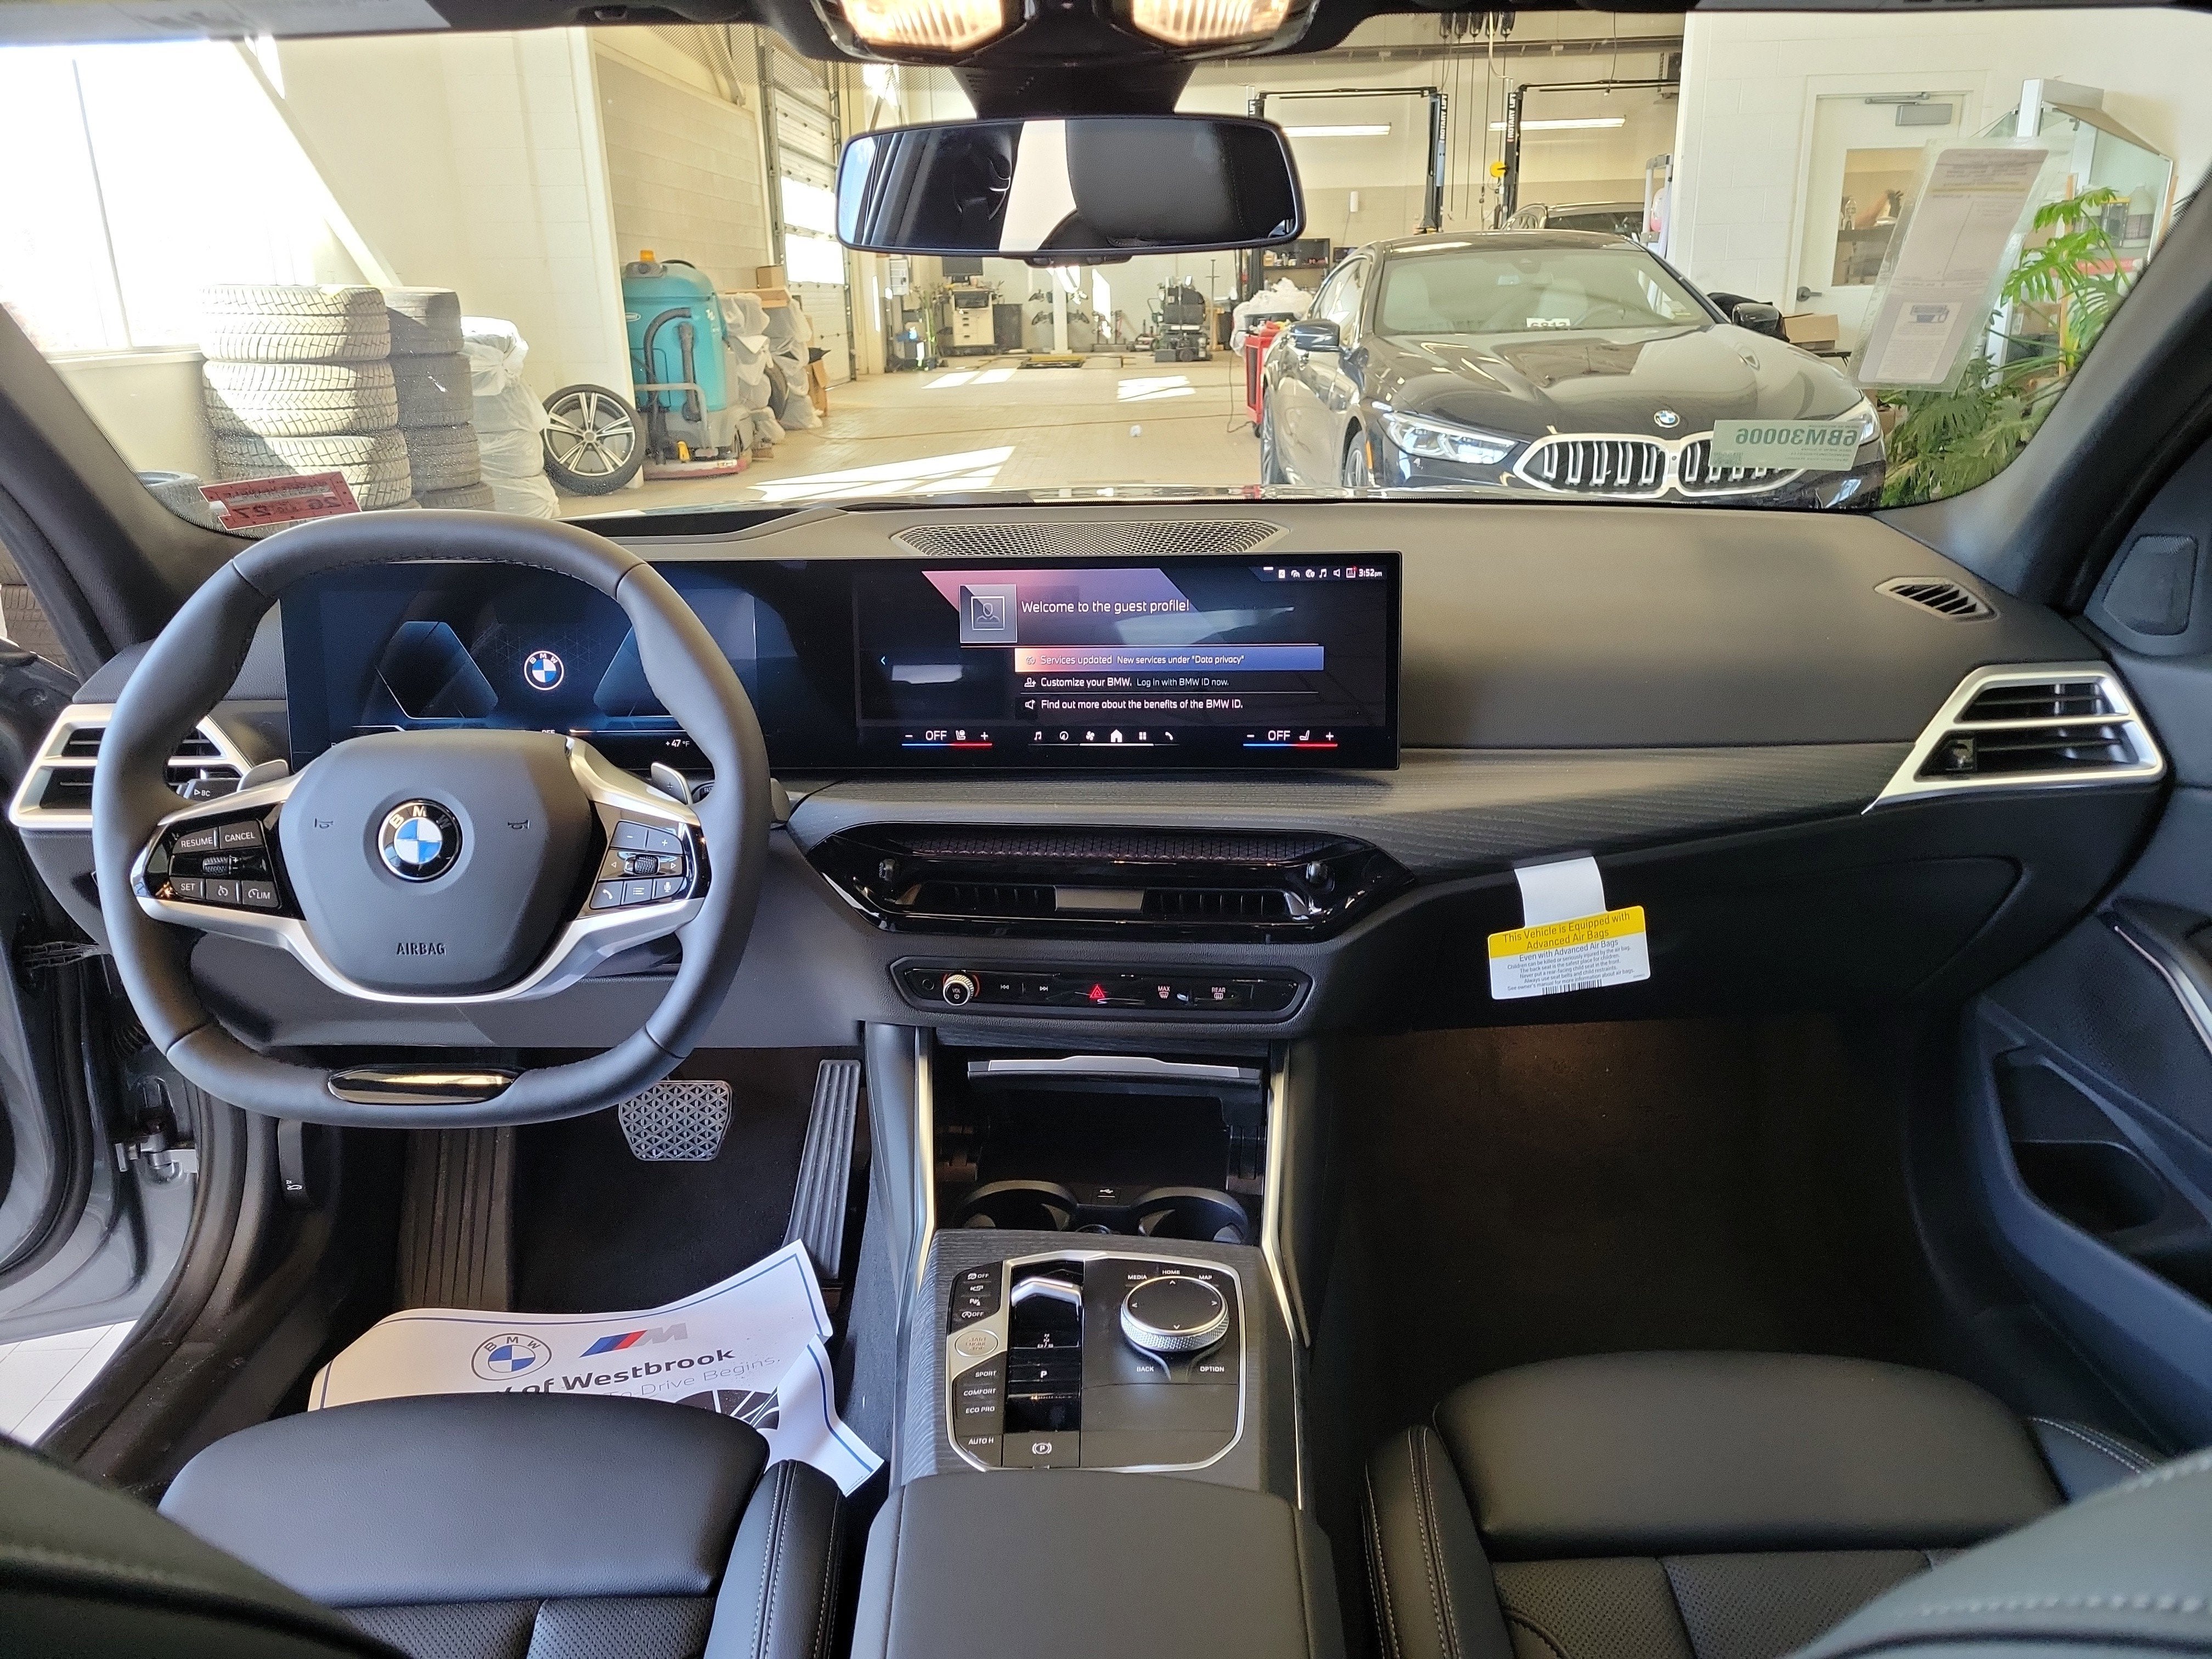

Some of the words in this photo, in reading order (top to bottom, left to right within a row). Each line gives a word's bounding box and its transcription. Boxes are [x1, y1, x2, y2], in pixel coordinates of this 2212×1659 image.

[1359, 569, 1382, 577] 3:52pm
[1022, 601, 1074, 613] Welcome
[1078, 601, 1089, 612] to
[1092, 600, 1111, 612] the
[1114, 600, 1147, 614] guest
[1150, 599, 1190, 614] profile!
[1040, 656, 1075, 665] Services
[1077, 655, 1112, 666] updated
[1117, 656, 1134, 664] New
[1136, 656, 1166, 664] services
[1168, 655, 1190, 664] under
[1192, 655, 1213, 664] "Data
[1215, 655, 1244, 665] privacy"
[1041, 678, 1085, 687] Customize
[1087, 679, 1105, 689] your
[1107, 678, 1132, 687] BMW.
[1137, 678, 1151, 687] Log
[1161, 678, 1177, 686] with
[1179, 678, 1199, 686] BMW
[1201, 678, 1209, 686] ID
[1041, 699, 1060, 709] Find
[1062, 701, 1076, 709] out
[1102, 699, 1126, 709] about
[1128, 699, 1142, 709] the
[1144, 699, 1177, 709] benefits
[1180, 699, 1188, 709] of
[1190, 699, 1204, 709] the
[1206, 699, 1229, 709] BMW
[1232, 699, 1243, 709] ID.
[926, 731, 947, 741] OFF
[1268, 731, 1290, 741] OFF
[181, 837, 213, 848] RESUME
[225, 832, 255, 842] CANCEL
[181, 883, 195, 891] SET
[257, 891, 270, 900] LIM
[1503, 933, 1521, 943] This
[1524, 927, 1556, 939] Vehicle
[1569, 915, 1610, 932] Equipped
[1612, 912, 1629, 923] with
[1527, 935, 1570, 950] Advanced
[1573, 933, 1584, 943] Air
[1587, 929, 1609, 939] Bags
[396, 942, 447, 956] AIRBAG
[1538, 951, 1553, 959] with
[1555, 945, 1588, 956] Advanced
[1590, 942, 1599, 950] Air
[1601, 940, 1618, 948] Bags
[484, 1336, 541, 1352] BMW
[562, 1349, 736, 1391] Westbrook
[641, 1376, 695, 1396] Drive
[704, 1358, 780, 1381] Begins.
[963, 1388, 996, 1396] COMFORT
